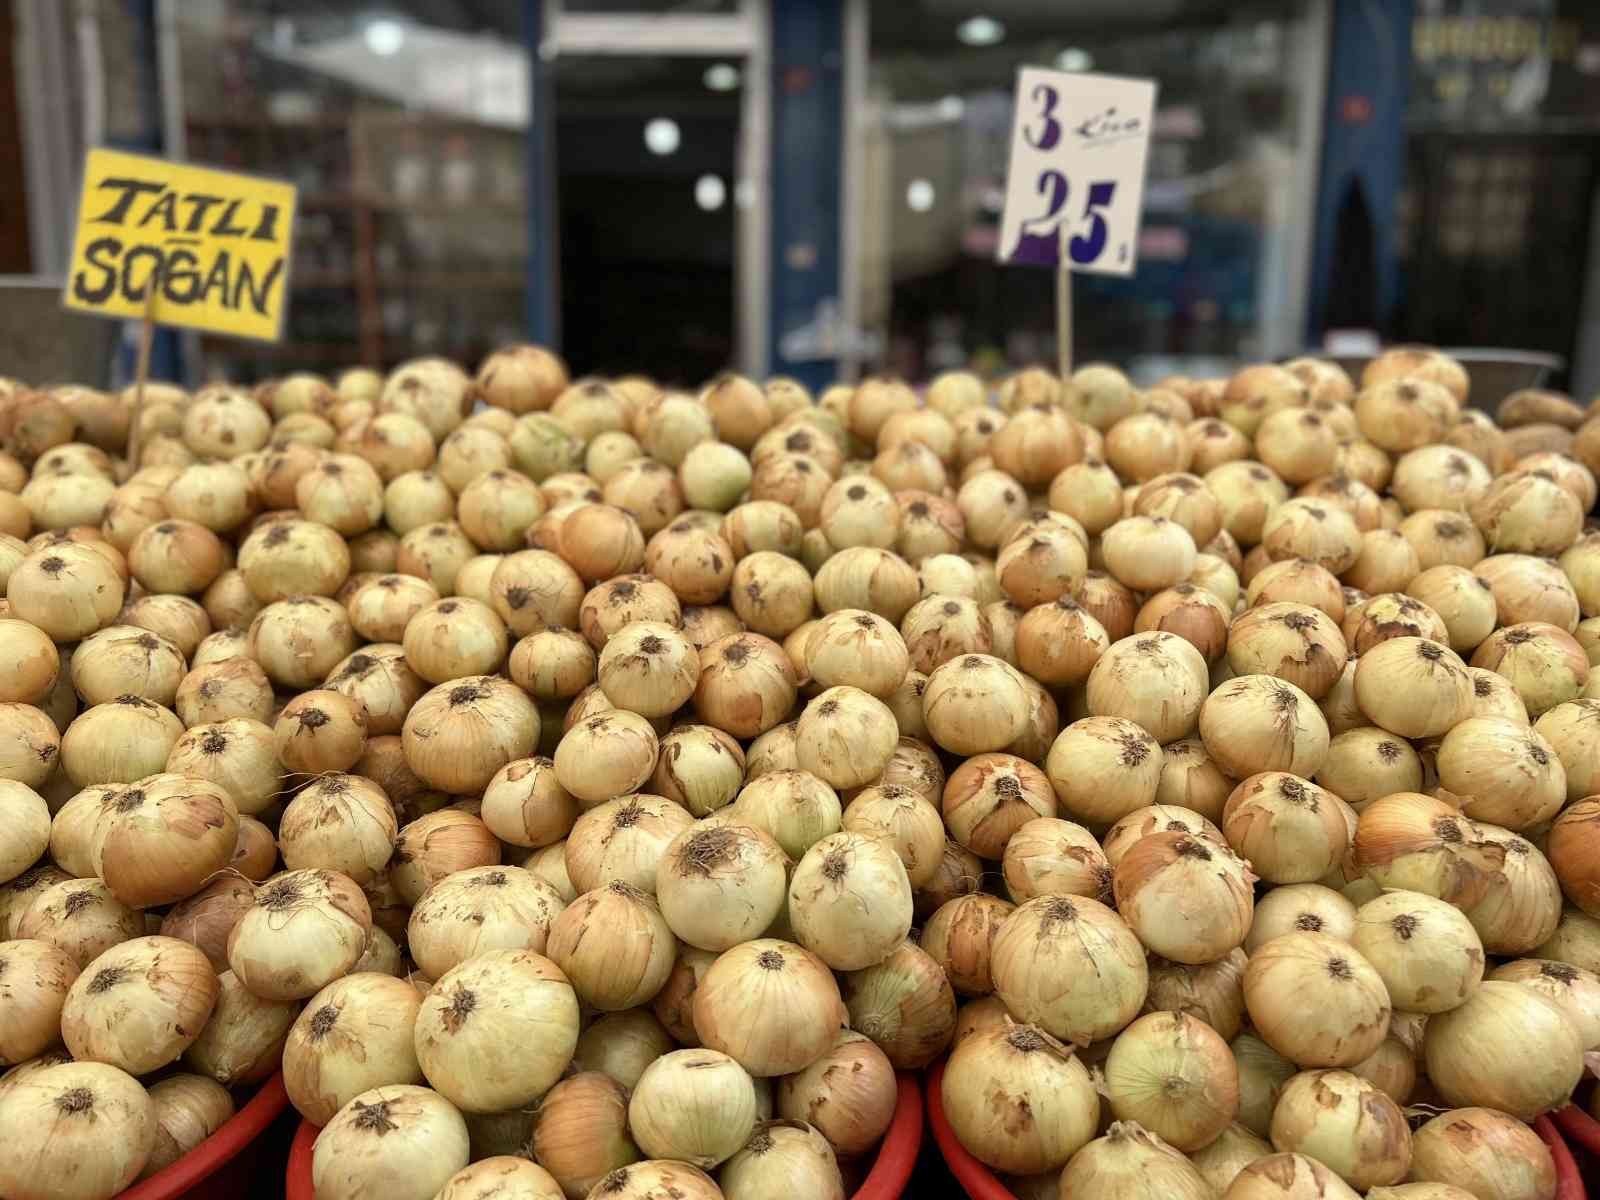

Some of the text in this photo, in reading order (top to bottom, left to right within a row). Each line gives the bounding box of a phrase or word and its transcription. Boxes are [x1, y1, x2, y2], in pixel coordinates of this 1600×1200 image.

[1024, 84, 1062, 153] 3
[88, 178, 279, 242] TATLI
[1012, 169, 1117, 264] 25
